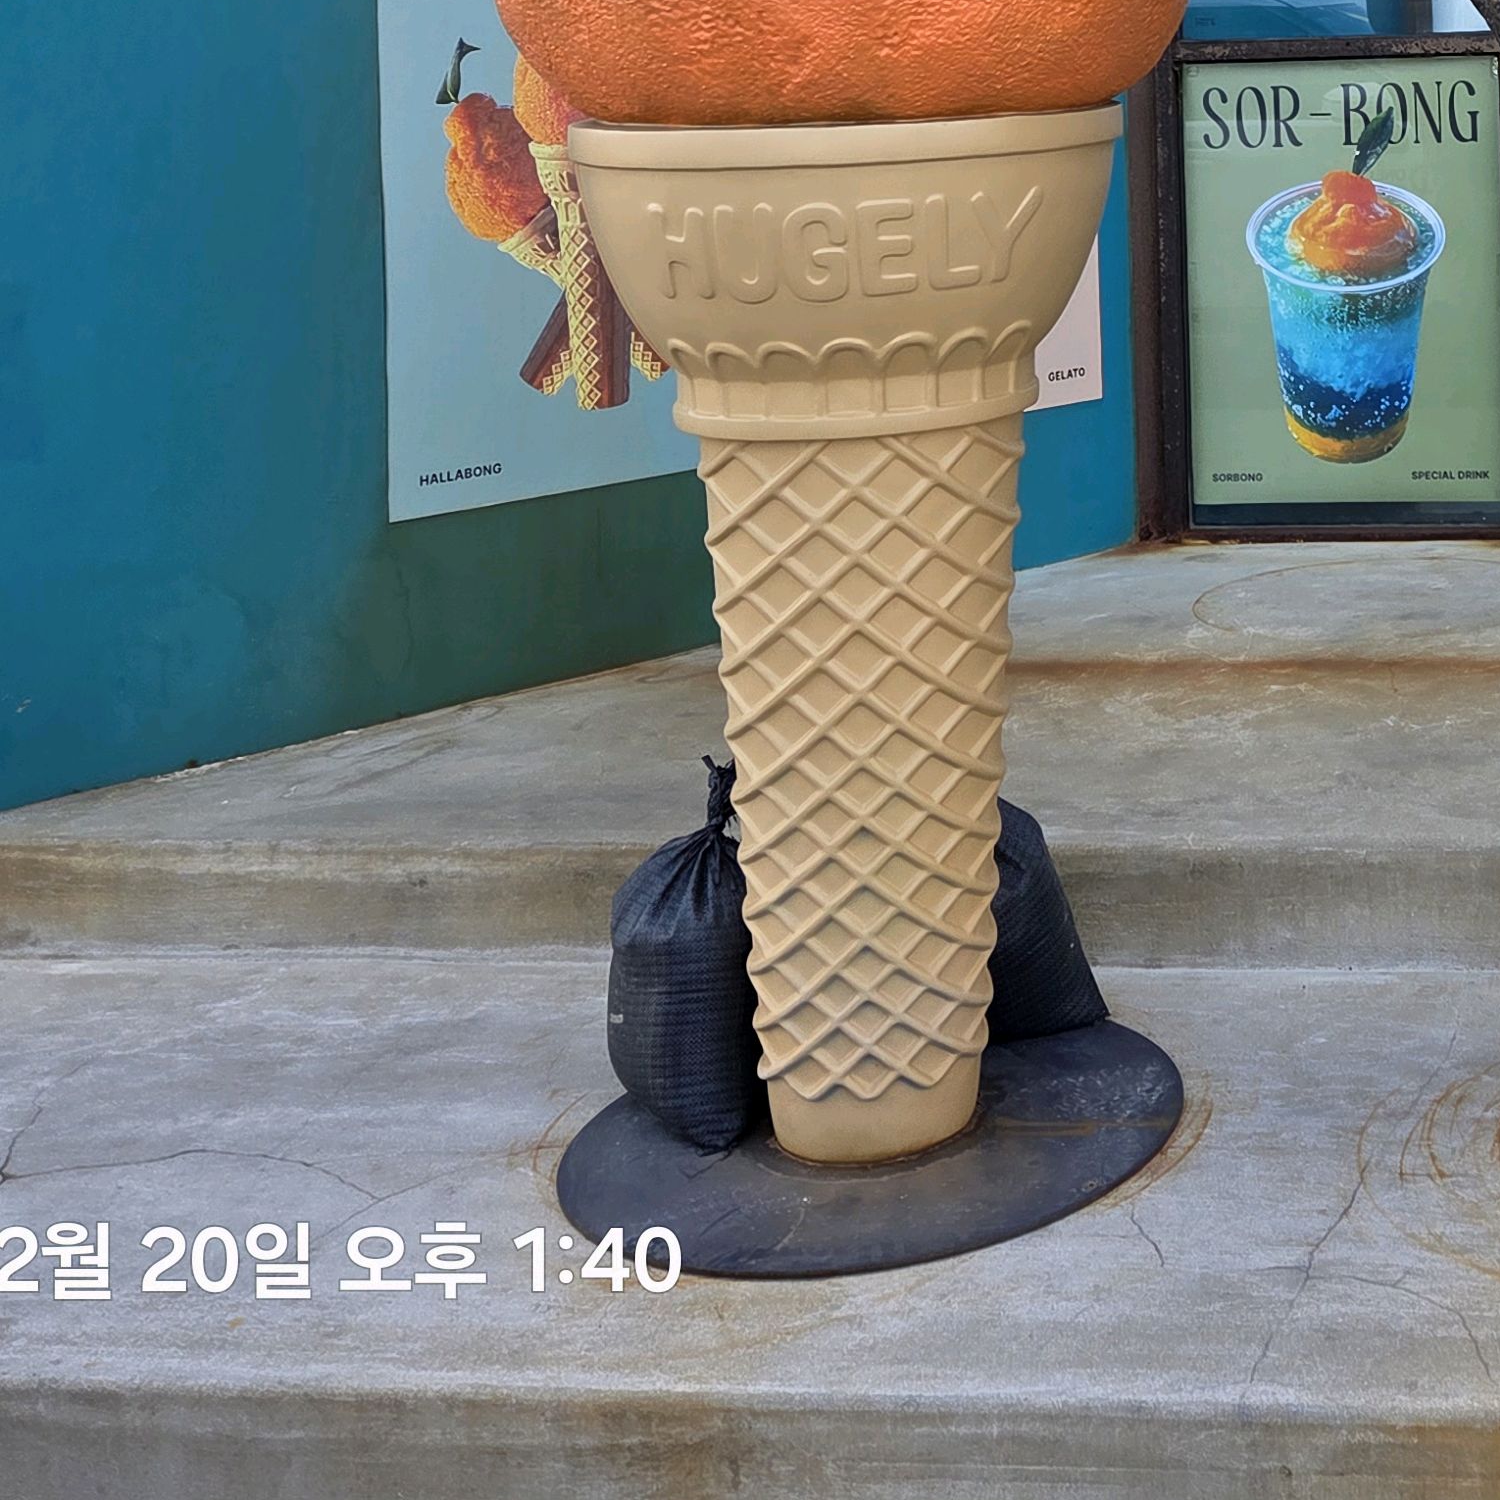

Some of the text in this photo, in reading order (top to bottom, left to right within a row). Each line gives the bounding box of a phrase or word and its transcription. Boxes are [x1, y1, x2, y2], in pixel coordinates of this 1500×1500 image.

[1202, 80, 1480, 150] SOR-BONG
[646, 185, 1043, 304] HUGELY
[1048, 367, 1086, 382] GELATO
[419, 463, 503, 487] HALLABONG
[1212, 473, 1264, 483] SORBONG
[1411, 470, 1490, 481] SPECIAL DRINK
